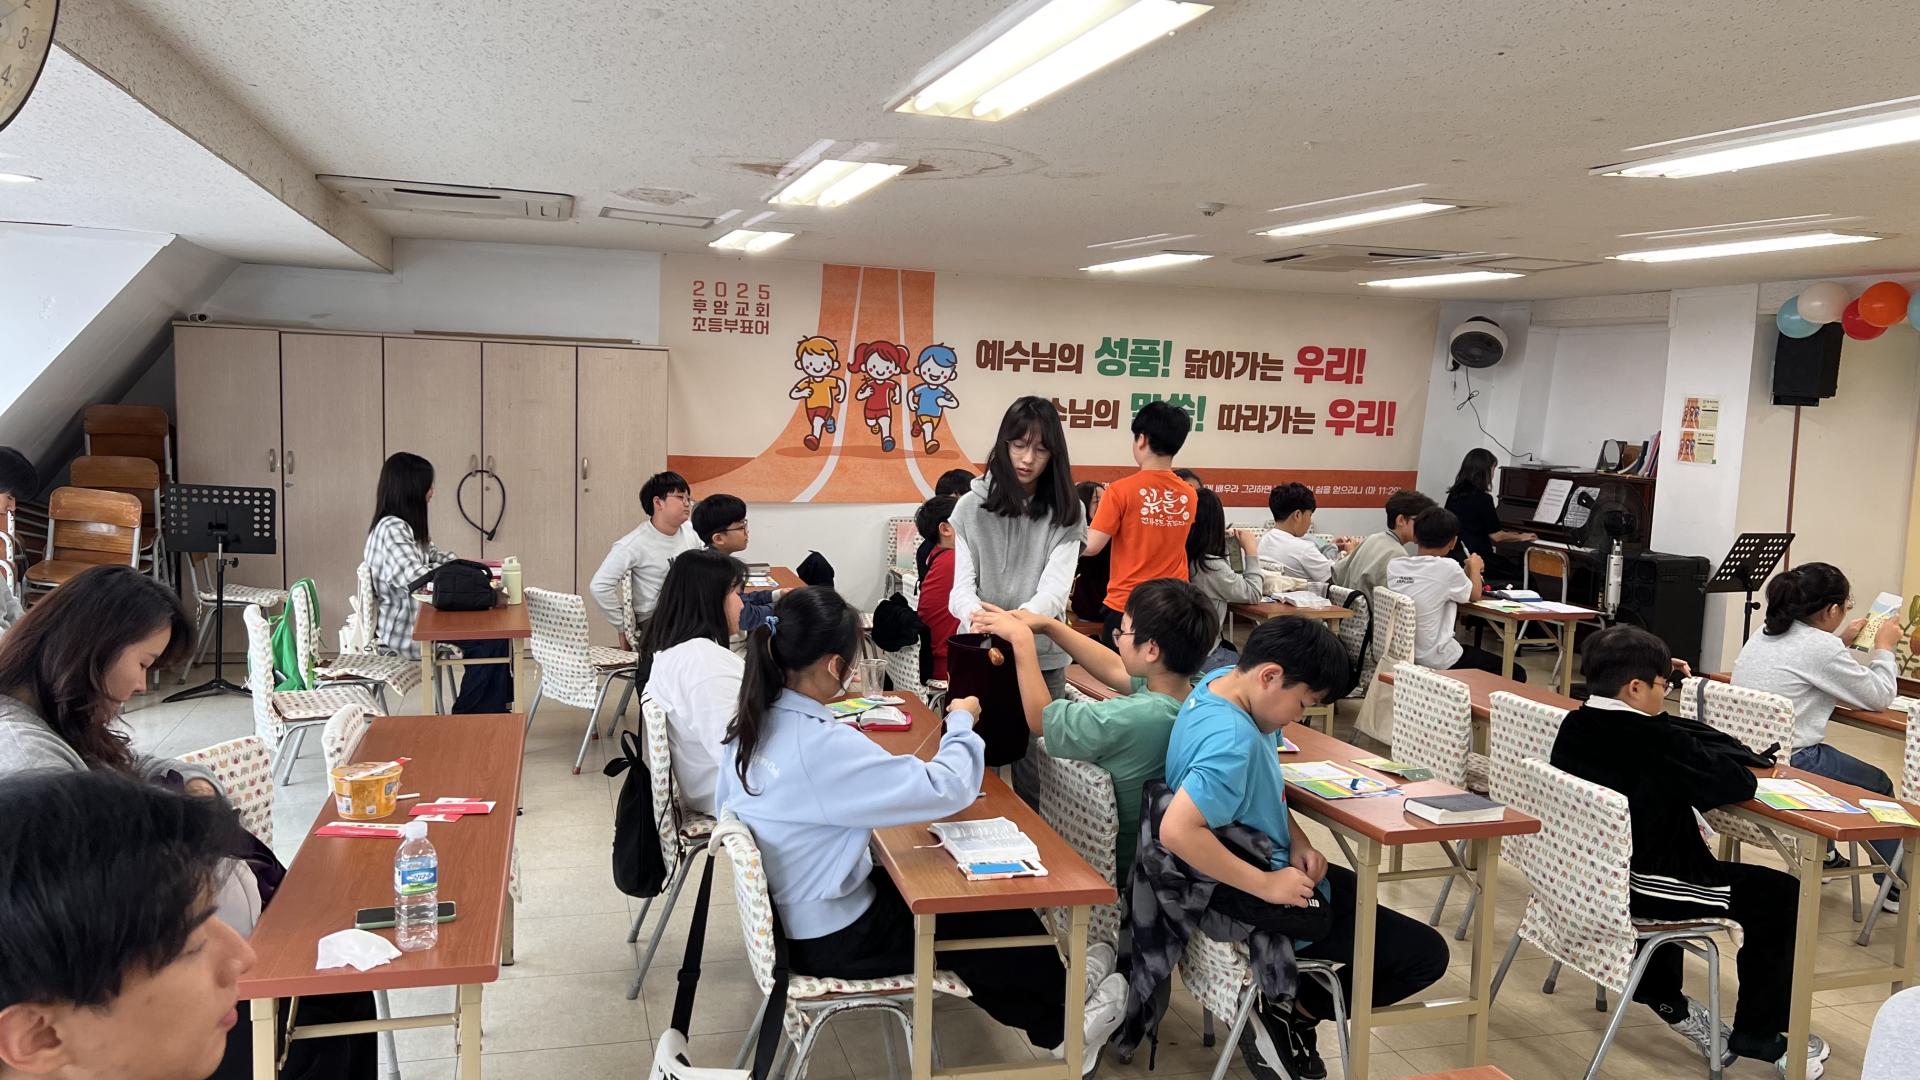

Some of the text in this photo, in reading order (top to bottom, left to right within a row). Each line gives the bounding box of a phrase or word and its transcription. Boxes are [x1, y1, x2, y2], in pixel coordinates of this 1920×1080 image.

[18, 26, 29, 49] 3
[1, 64, 12, 86] 4
[693, 280, 770, 300] 2025
[692, 298, 770, 318] 후암교회
[692, 316, 770, 335] 초등부표어
[975, 336, 1367, 384] 예수님의 성품! 닮아가는 우리!
[1217, 403, 1316, 434] 따라가는
[1325, 398, 1397, 437] 우리!
[1214, 484, 1240, 494] 배우라
[1240, 484, 1273, 495] 그리하면
[1332, 485, 1364, 495] 얻으리니
[1378, 486, 1402, 496] 11:29
